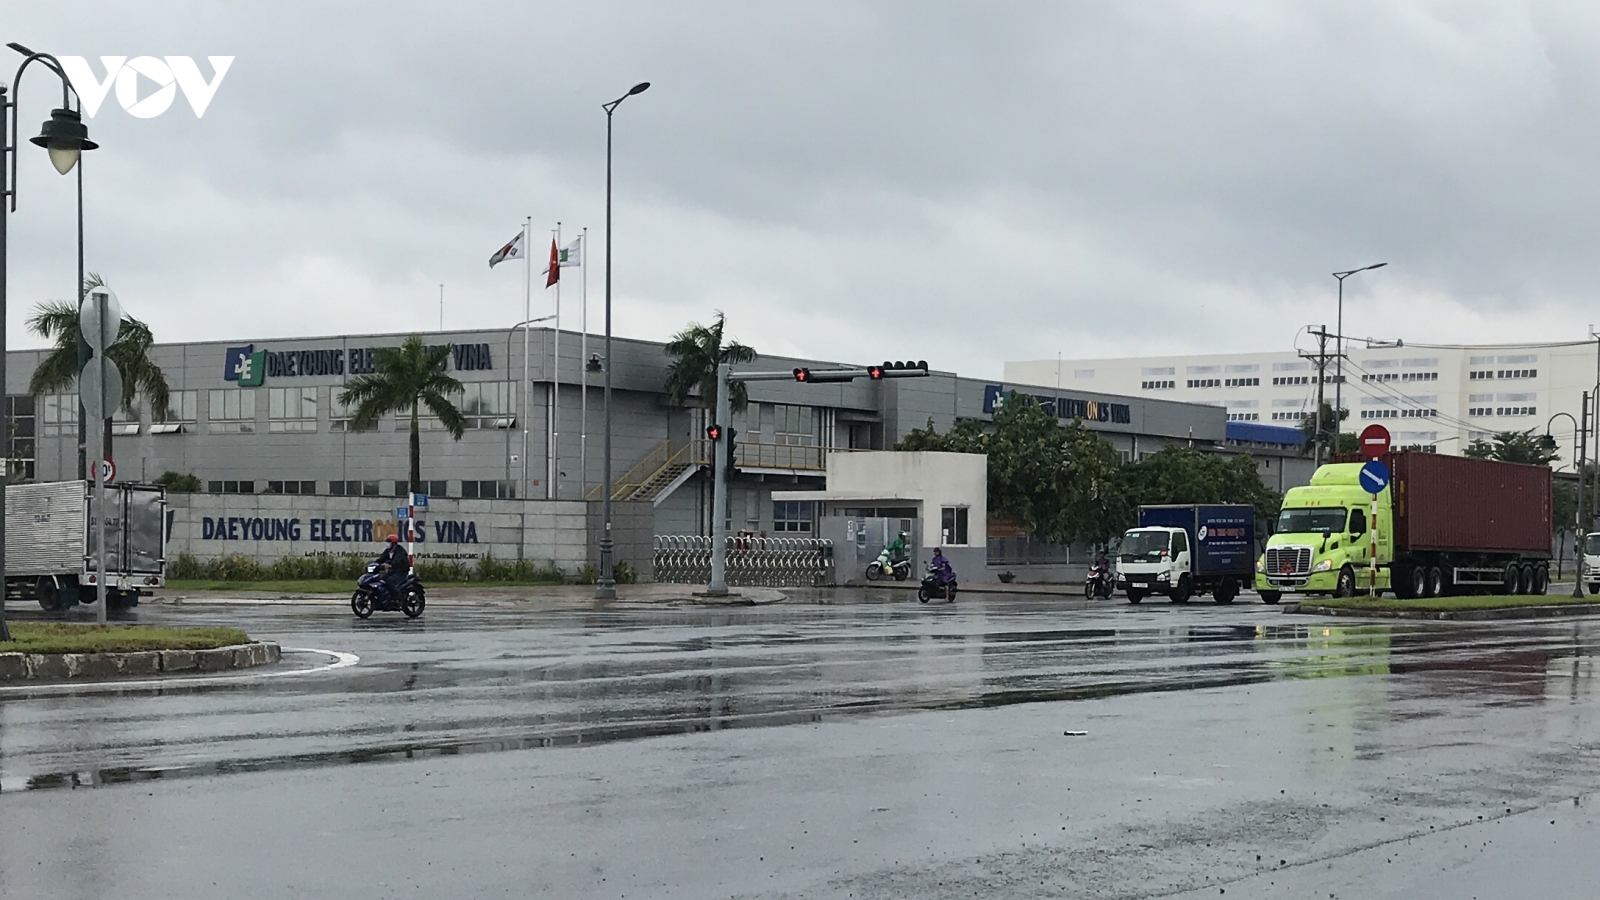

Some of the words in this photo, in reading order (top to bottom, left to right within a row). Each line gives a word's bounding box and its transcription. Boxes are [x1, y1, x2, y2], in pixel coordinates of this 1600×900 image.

[267, 349, 344, 377] DAEYOUNG
[453, 343, 492, 370] VINA
[202, 516, 301, 541] DAEYOUNG
[435, 520, 479, 543] VINA
